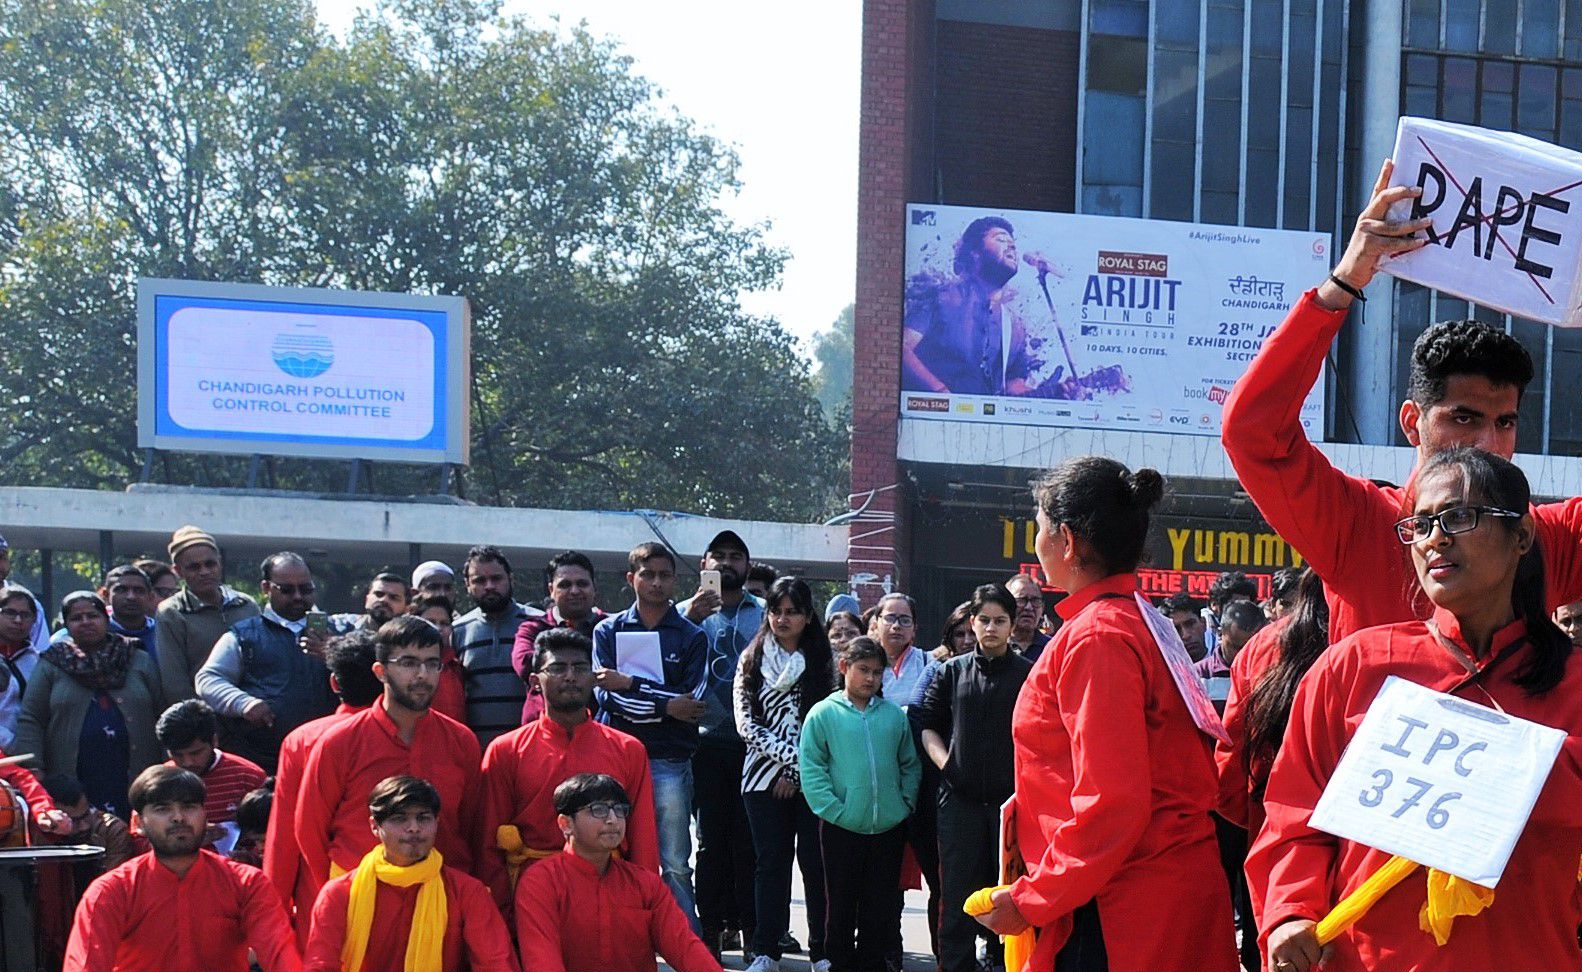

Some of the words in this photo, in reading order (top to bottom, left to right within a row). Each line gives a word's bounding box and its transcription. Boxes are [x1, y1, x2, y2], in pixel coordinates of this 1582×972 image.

[1408, 162, 1571, 279] RAPE
[1188, 231, 1261, 245] #ArijitSinghLive
[1098, 256, 1134, 269] ROYAL
[1137, 259, 1166, 271] STAG
[1082, 275, 1182, 311] ARIJIT
[1221, 299, 1290, 311] CHANDIGARH
[1082, 307, 1175, 325] SINGH
[1187, 336, 1262, 350] EXHIBITION
[198, 379, 308, 397] CHANDIGARH
[314, 386, 405, 402] POLLUTION
[212, 397, 292, 413] CONTROL
[297, 402, 391, 418] COMMITTEE
[1137, 572, 1182, 592] THE
[1380, 714, 1488, 778] IPC
[1358, 769, 1462, 830] 376
